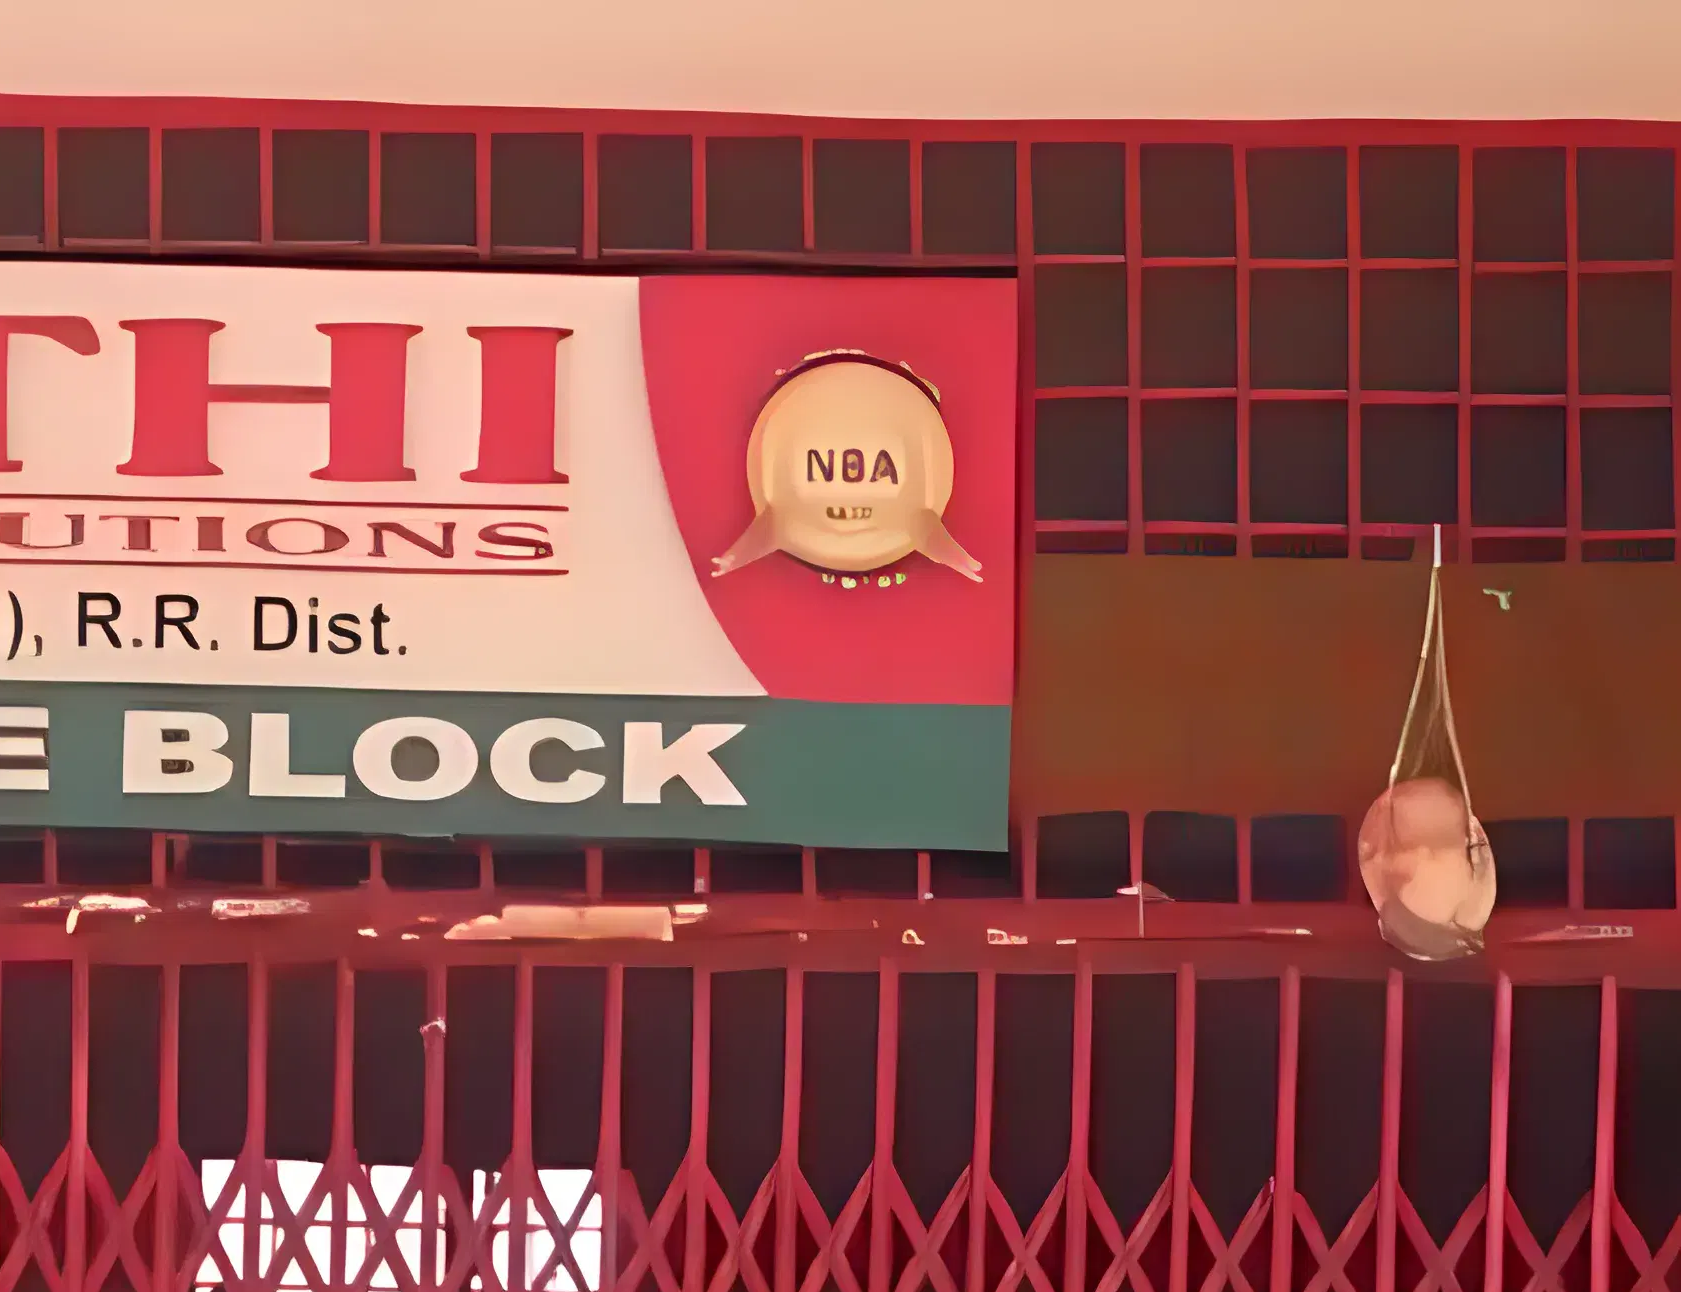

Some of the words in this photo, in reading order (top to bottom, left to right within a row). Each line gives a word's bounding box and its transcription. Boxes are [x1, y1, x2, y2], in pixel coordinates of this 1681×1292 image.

[76, 591, 220, 653] R.R.
[254, 596, 408, 656] Dist.
[121, 709, 747, 807] BLOCK
